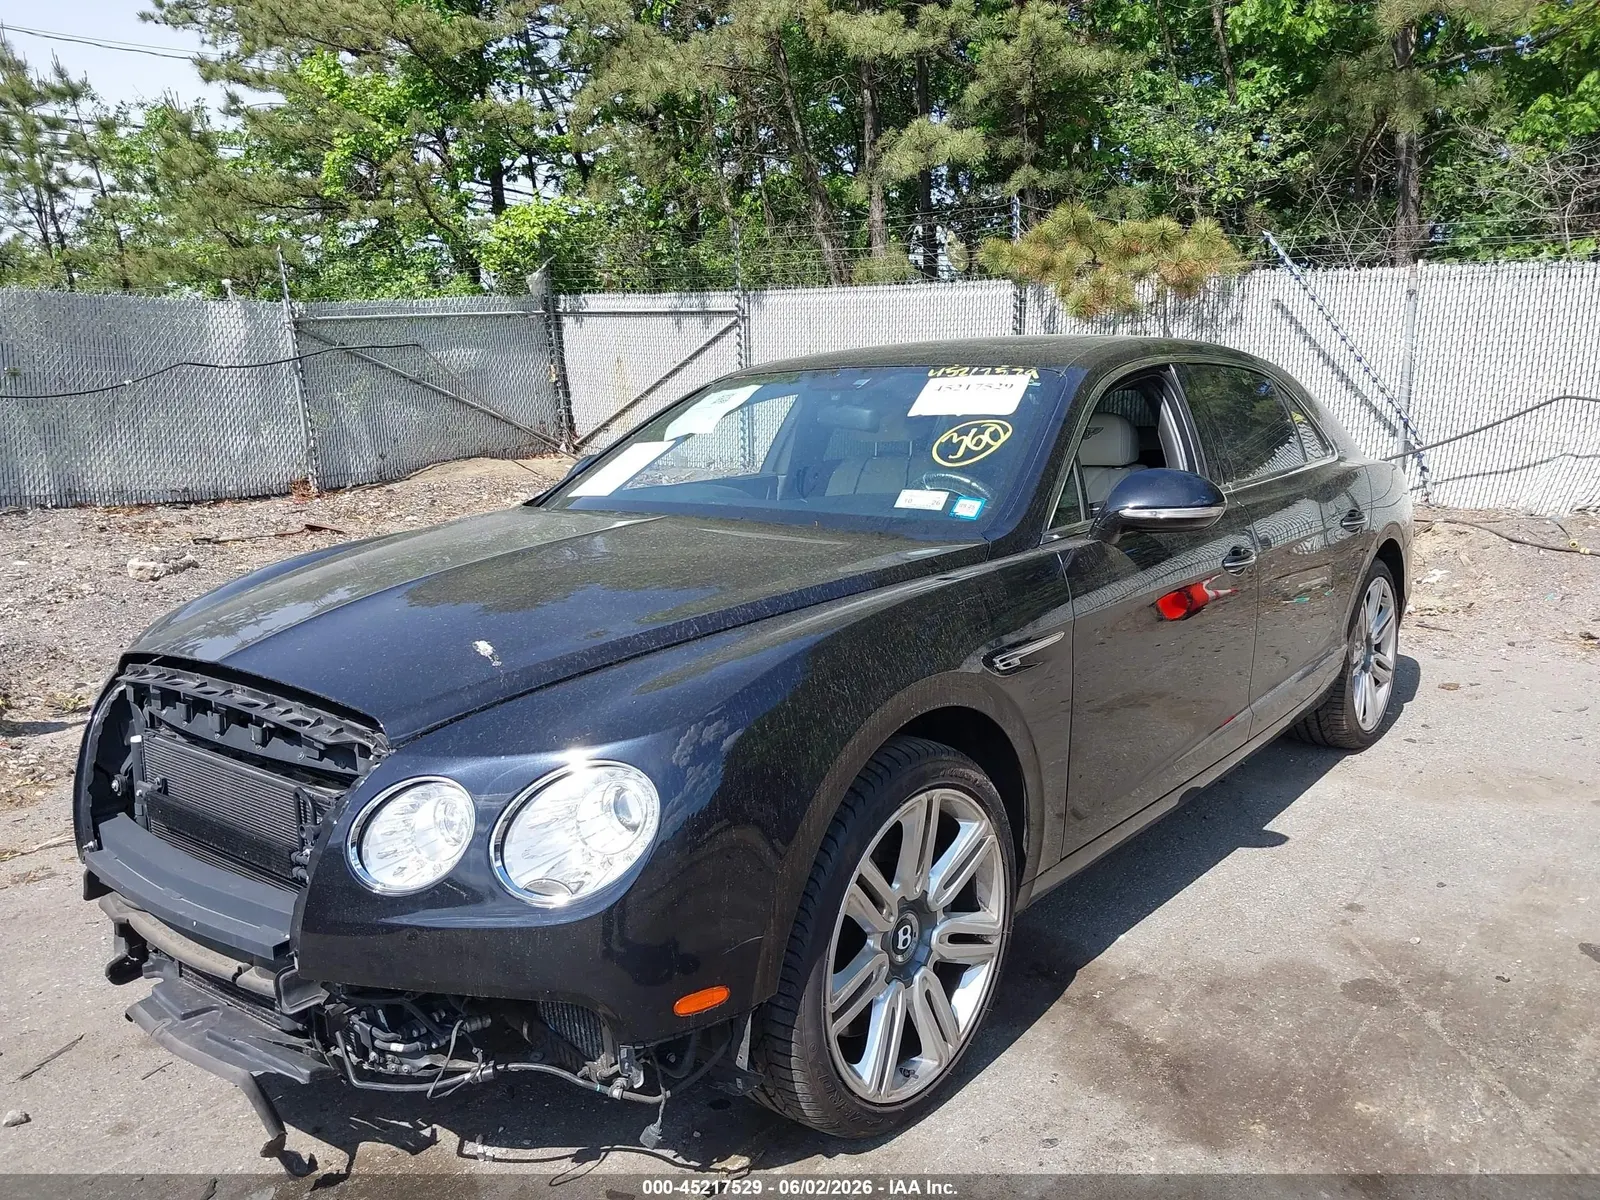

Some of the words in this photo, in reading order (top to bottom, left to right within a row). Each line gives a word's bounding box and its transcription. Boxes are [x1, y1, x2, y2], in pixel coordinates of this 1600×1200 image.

[934, 383, 1014, 392] 45217529
[940, 423, 1004, 459] 360
[897, 924, 913, 950] B
